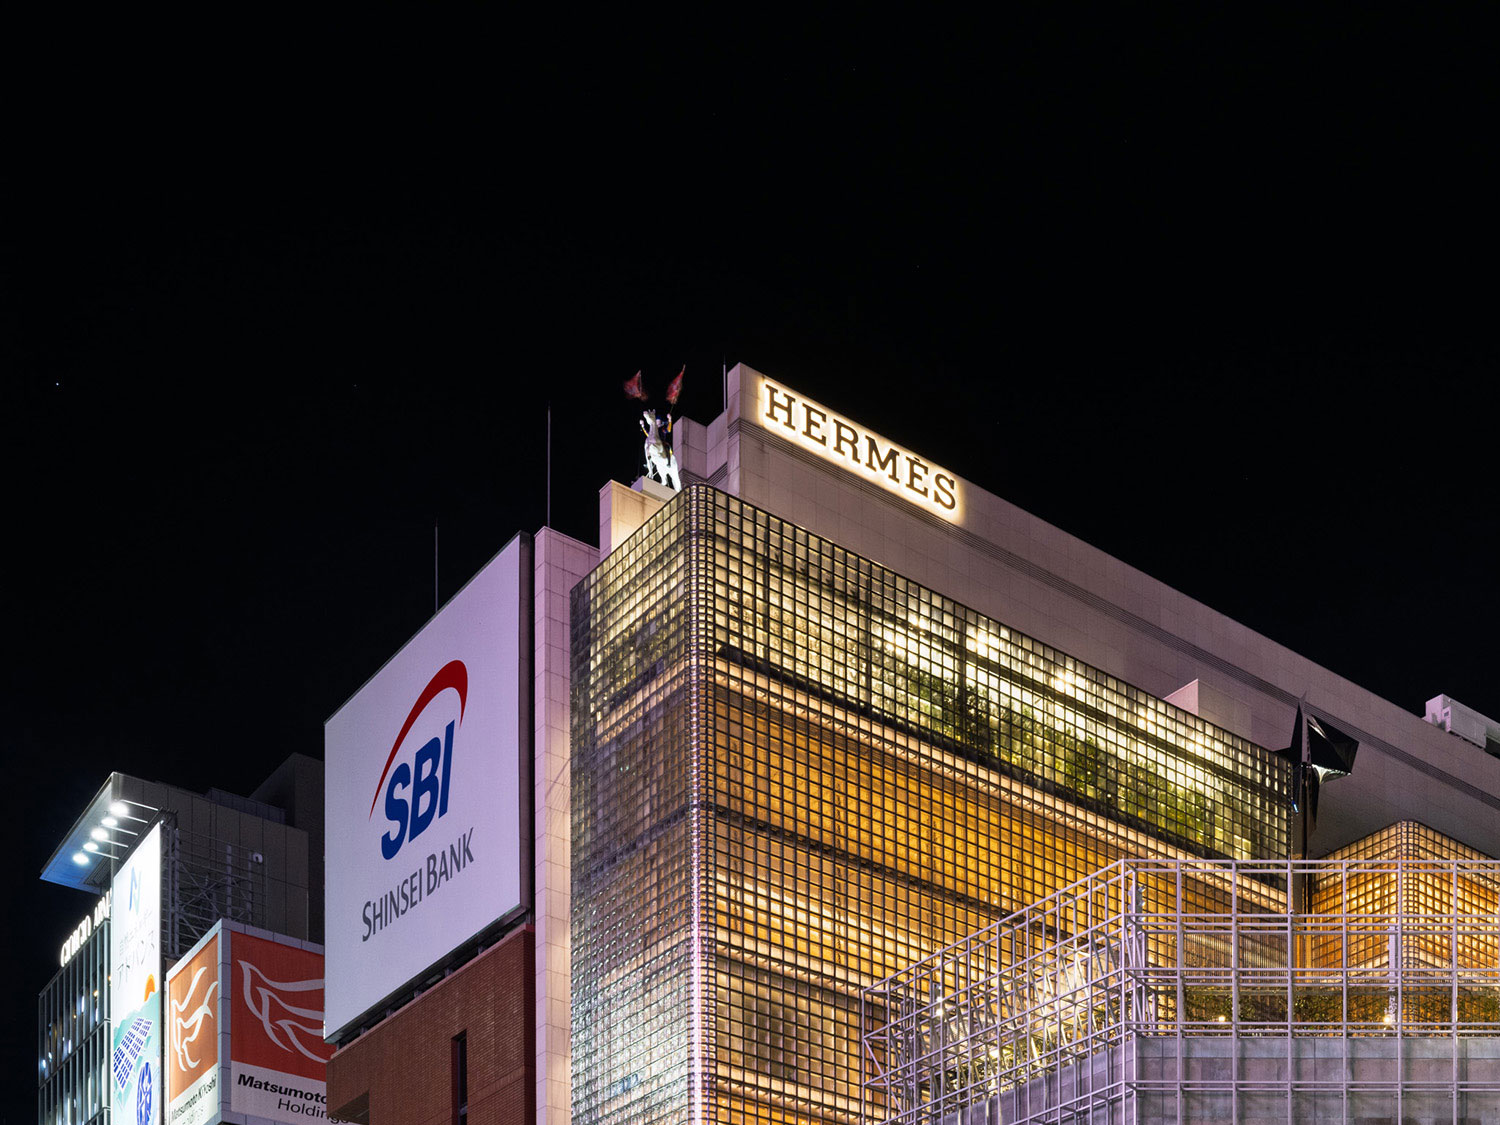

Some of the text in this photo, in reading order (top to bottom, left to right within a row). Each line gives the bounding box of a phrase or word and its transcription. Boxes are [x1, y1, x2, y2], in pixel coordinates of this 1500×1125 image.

[381, 719, 455, 860] SBI
[362, 827, 474, 942] SHINSEI BANK
